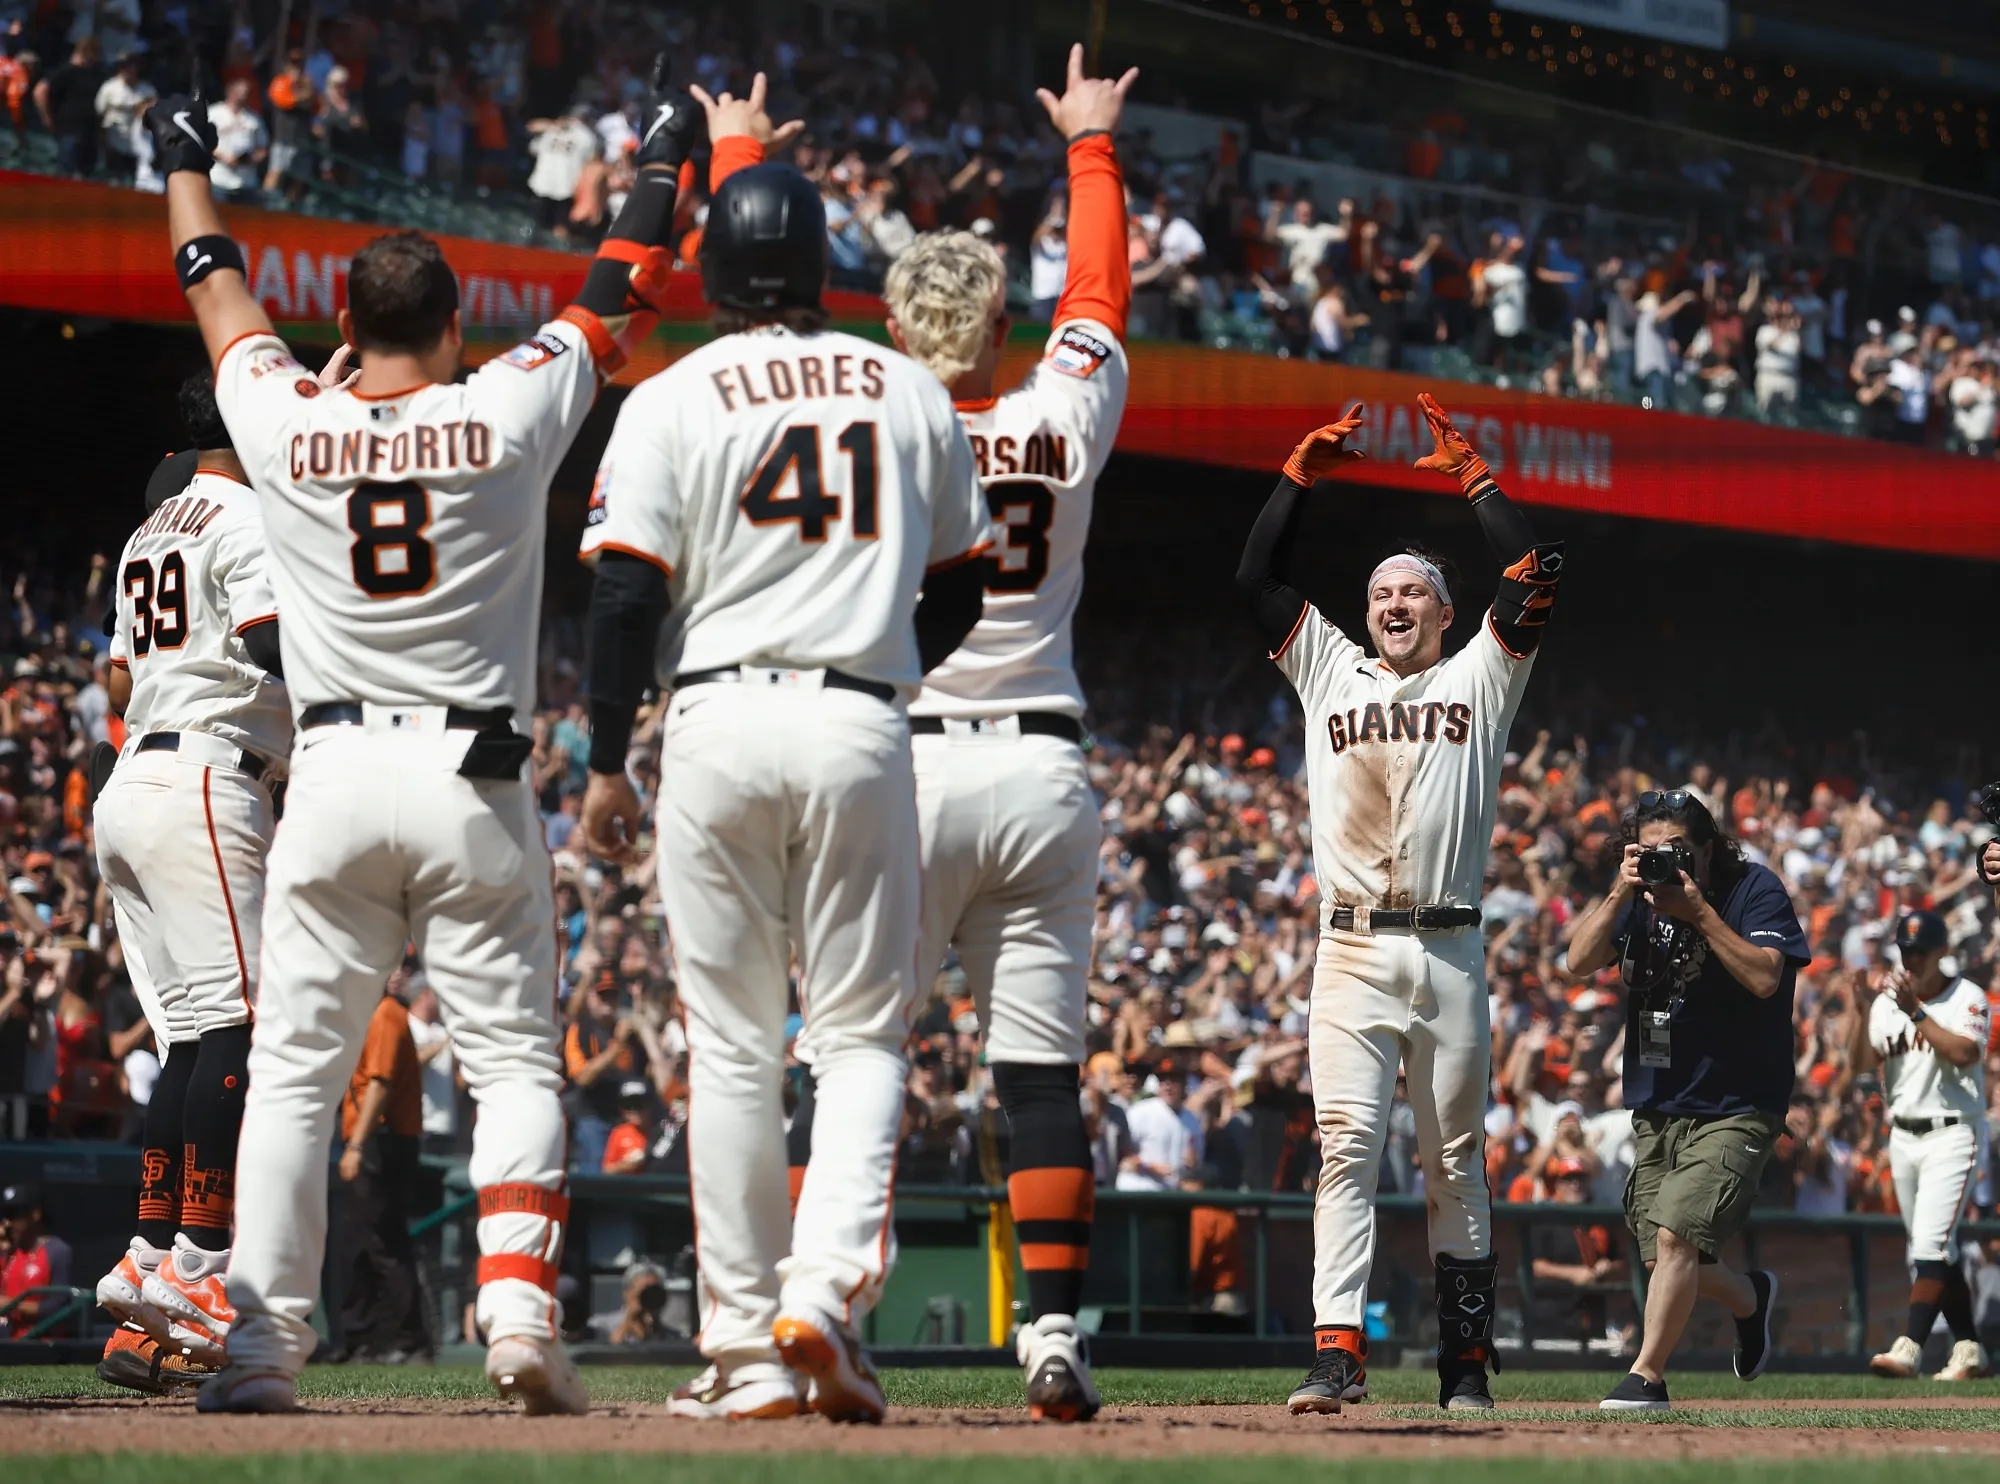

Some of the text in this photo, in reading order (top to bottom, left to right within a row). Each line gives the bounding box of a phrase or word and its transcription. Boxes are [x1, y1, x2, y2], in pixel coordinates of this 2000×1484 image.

[710, 355, 885, 413] FLORES
[290, 420, 492, 482] CONFORTO
[967, 434, 1068, 482] RSON
[739, 421, 880, 543] 41
[347, 480, 438, 599] 8
[983, 479, 1057, 595] 3
[123, 549, 190, 660] 39
[1327, 702, 1472, 756] GIANTS
[480, 1187, 550, 1214] ONFORTO
[1320, 1334, 1340, 1344] NIKE
